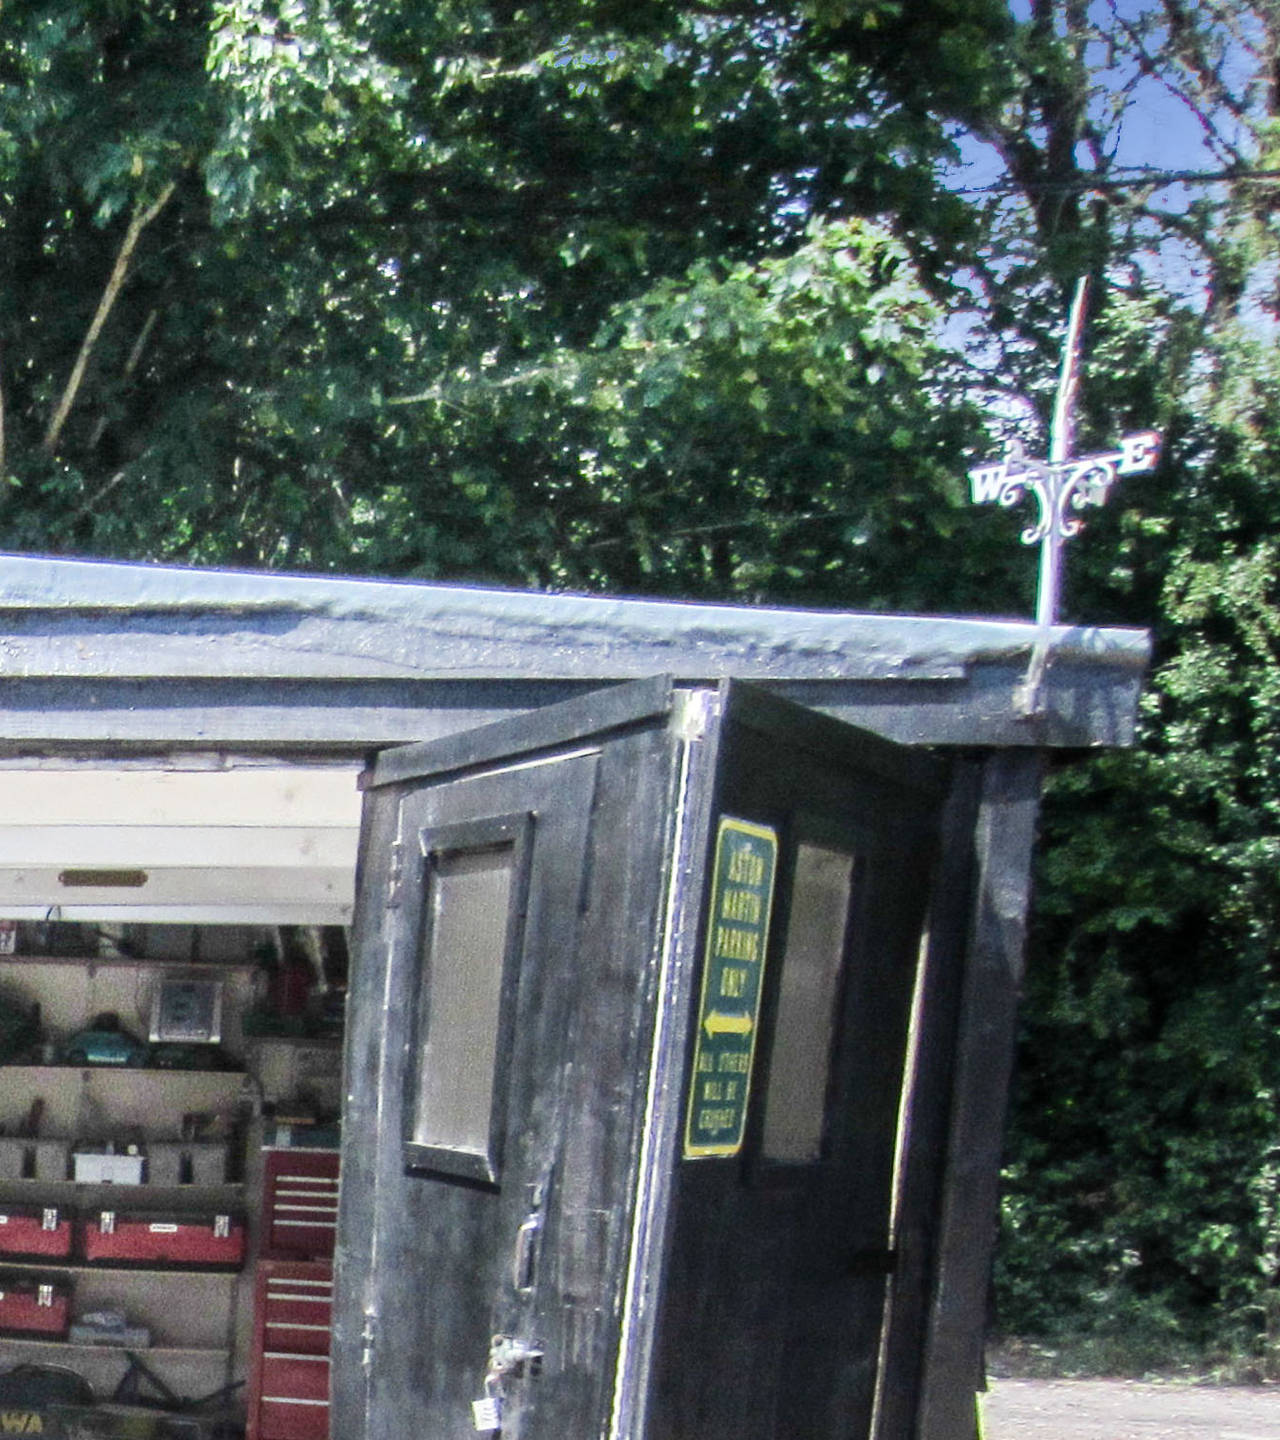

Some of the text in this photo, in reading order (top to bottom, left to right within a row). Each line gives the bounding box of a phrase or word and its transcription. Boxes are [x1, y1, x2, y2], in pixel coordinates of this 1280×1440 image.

[1118, 432, 1162, 475] E
[968, 466, 1006, 504] W
[715, 926, 759, 962] PARKING
[720, 967, 748, 998] ONLY
